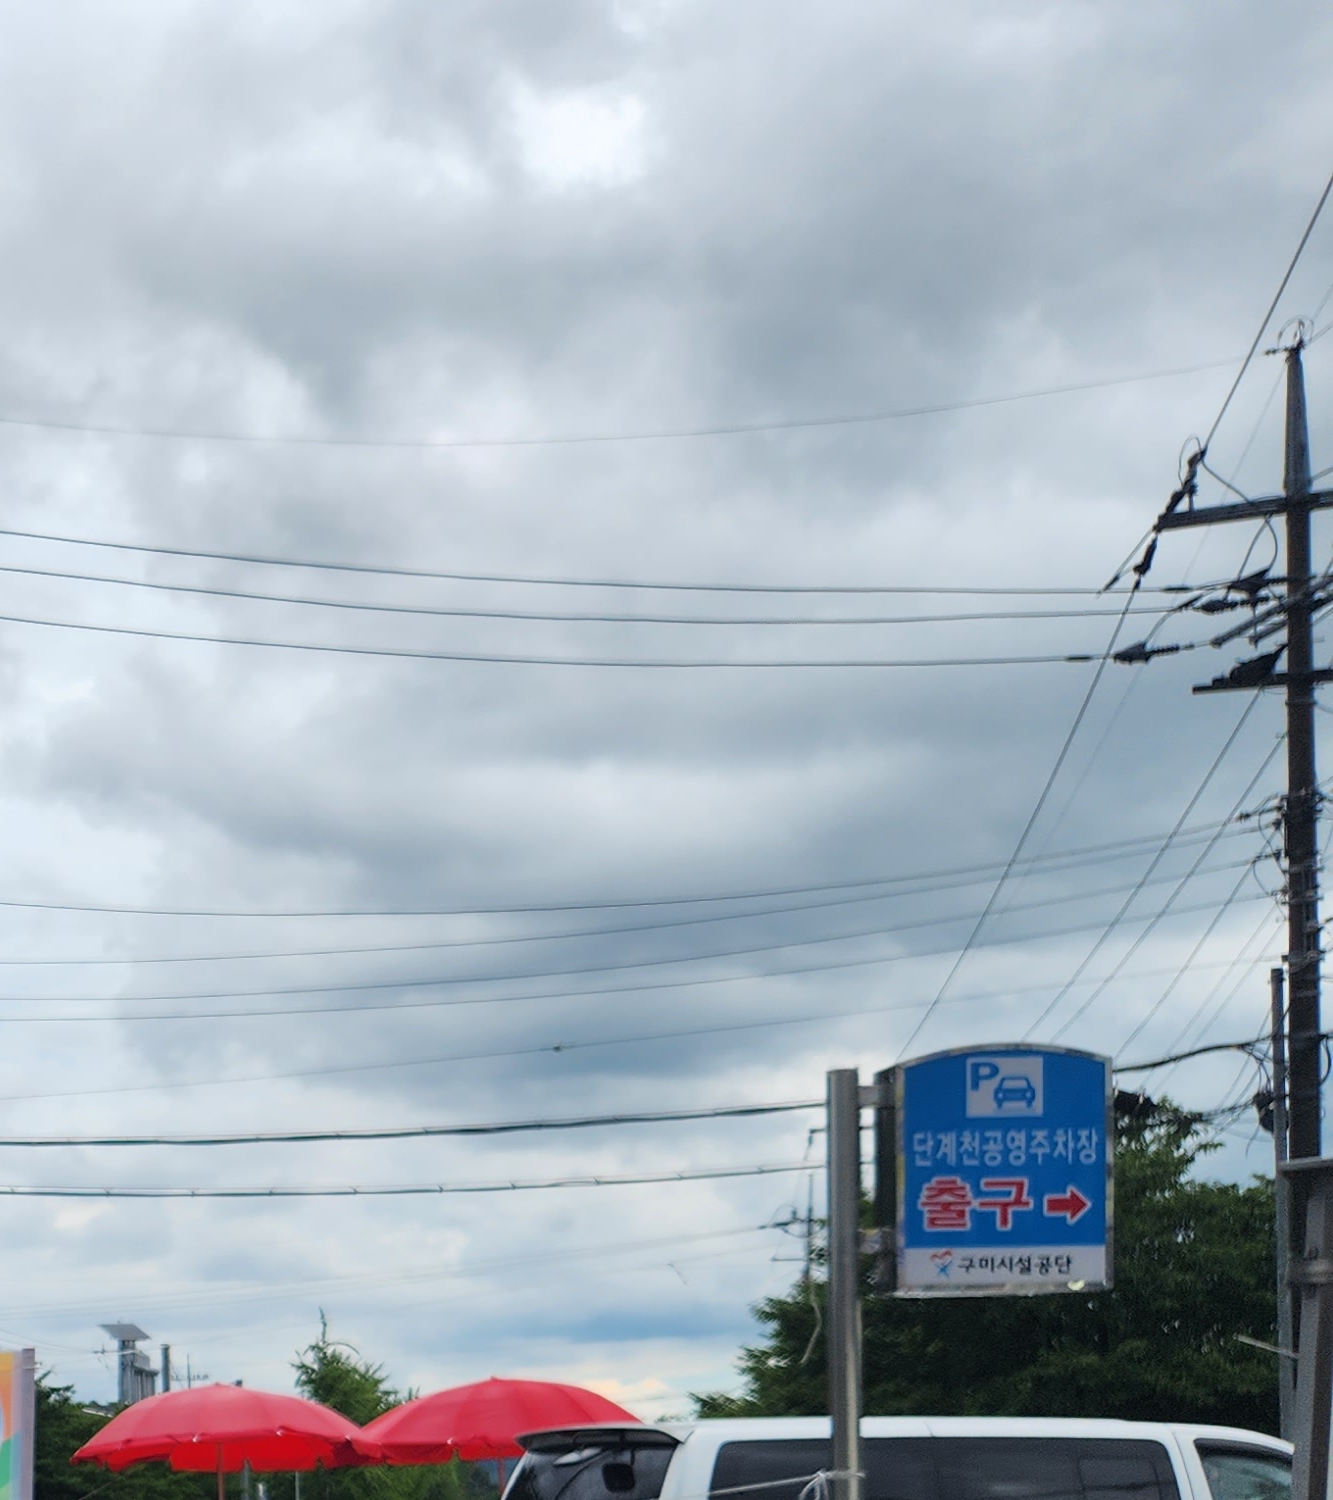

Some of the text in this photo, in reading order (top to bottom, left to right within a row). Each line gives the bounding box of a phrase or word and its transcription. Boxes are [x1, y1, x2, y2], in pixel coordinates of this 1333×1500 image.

[970, 1062, 1000, 1092] P
[913, 1127, 1099, 1168] 단계천공영주차장
[918, 1176, 1034, 1231] 출구
[957, 1255, 1074, 1276] 구미시설공단
